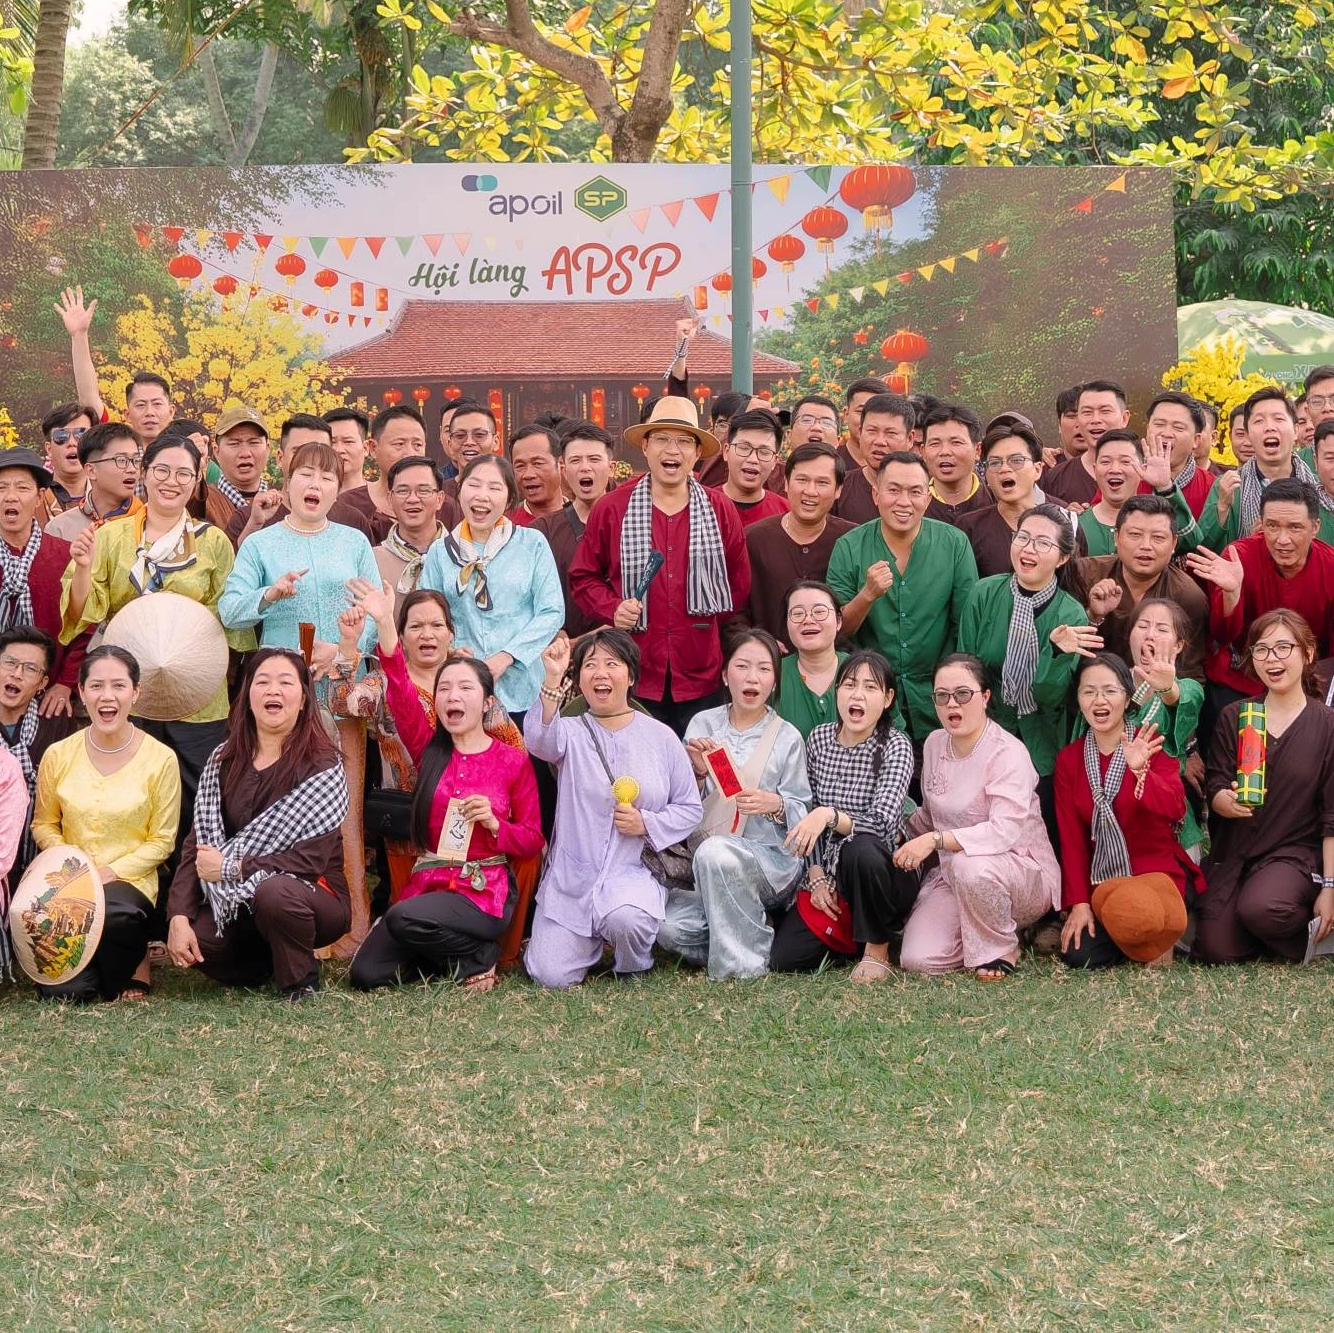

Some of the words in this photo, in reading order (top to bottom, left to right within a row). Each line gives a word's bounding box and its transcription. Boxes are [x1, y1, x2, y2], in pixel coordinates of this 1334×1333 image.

[488, 191, 562, 222] apoil
[583, 191, 618, 207] SP
[408, 262, 459, 296] Hội
[468, 257, 530, 298] làng
[541, 242, 682, 296] APSP
